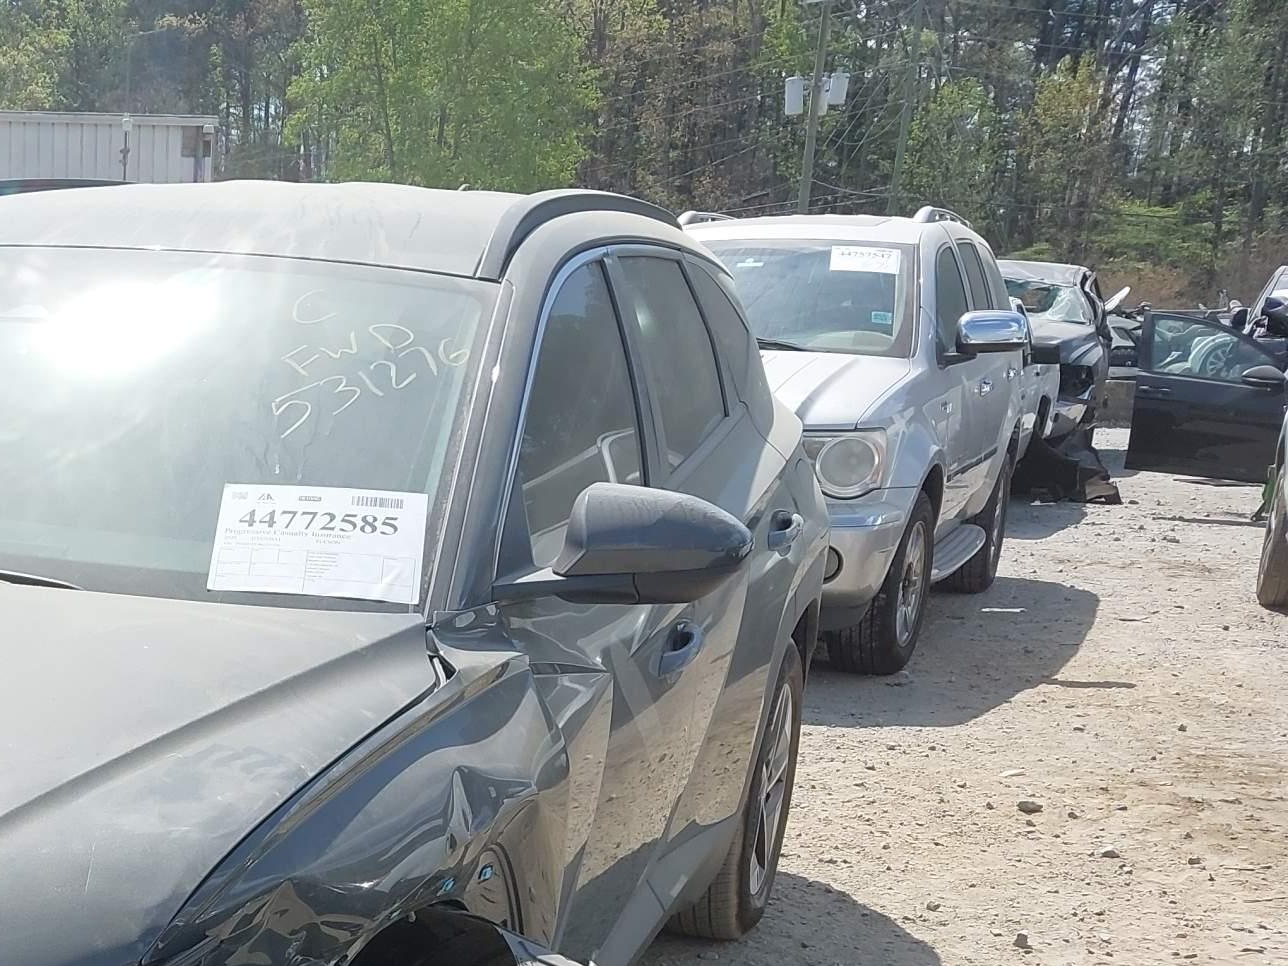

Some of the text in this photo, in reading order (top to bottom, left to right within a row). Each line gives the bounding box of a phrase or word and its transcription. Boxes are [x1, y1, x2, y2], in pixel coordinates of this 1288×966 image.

[293, 289, 336, 323] C
[281, 324, 414, 376] FWD
[224, 527, 271, 536] Progressive
[312, 530, 351, 539] Insurance
[238, 508, 399, 536] 44772585
